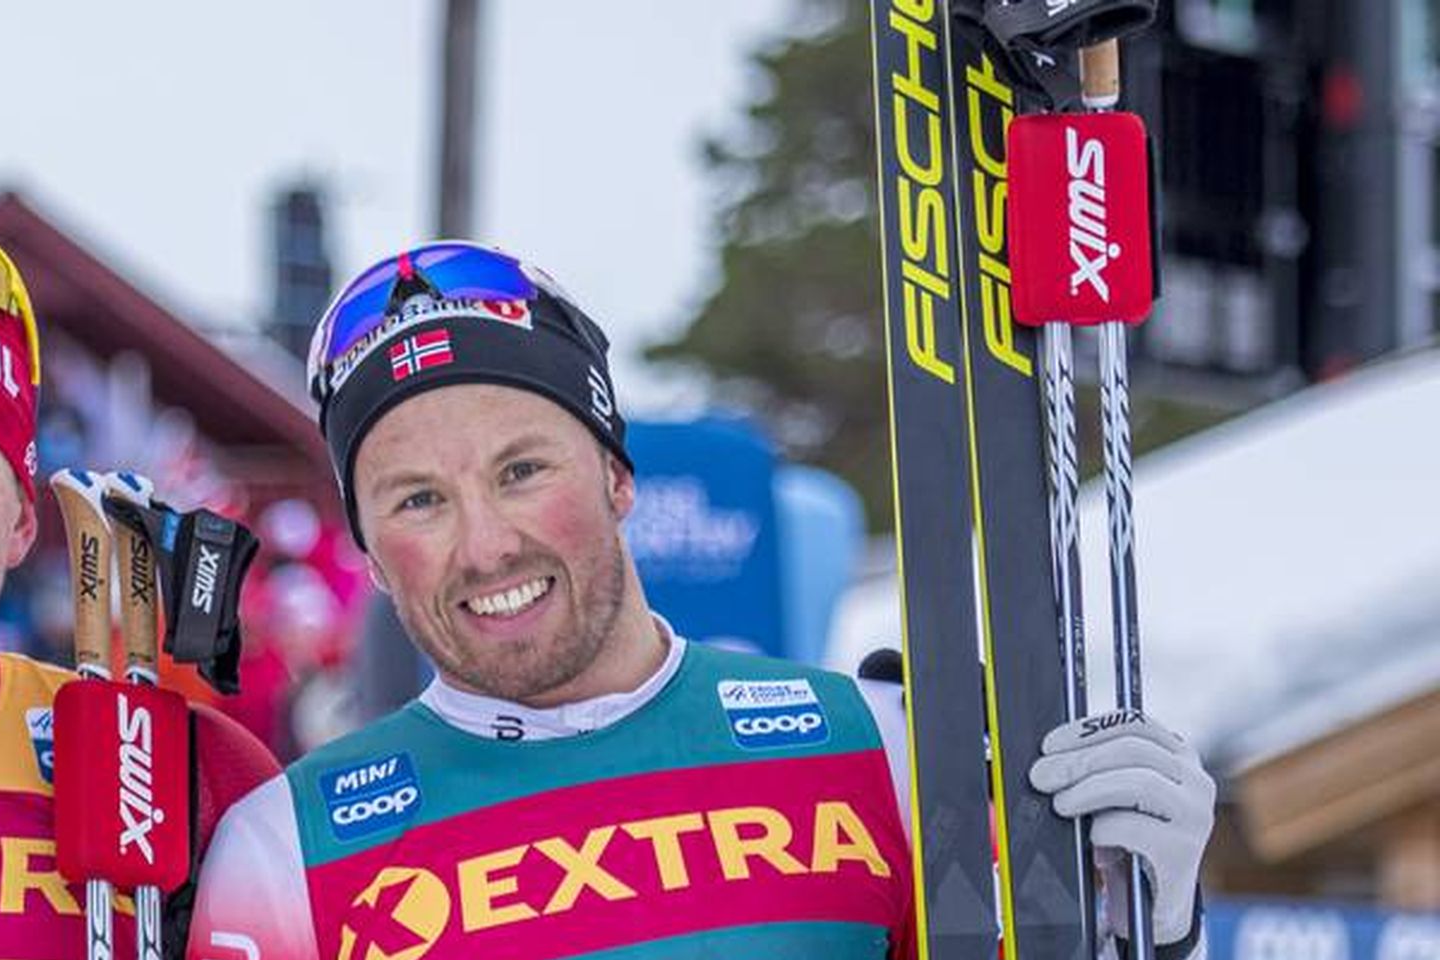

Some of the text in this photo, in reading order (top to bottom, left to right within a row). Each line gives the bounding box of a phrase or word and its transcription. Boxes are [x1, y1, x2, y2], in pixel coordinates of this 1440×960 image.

[888, 0, 955, 384] FISCH
[734, 712, 822, 735] coop
[457, 801, 892, 933] EXTRA
